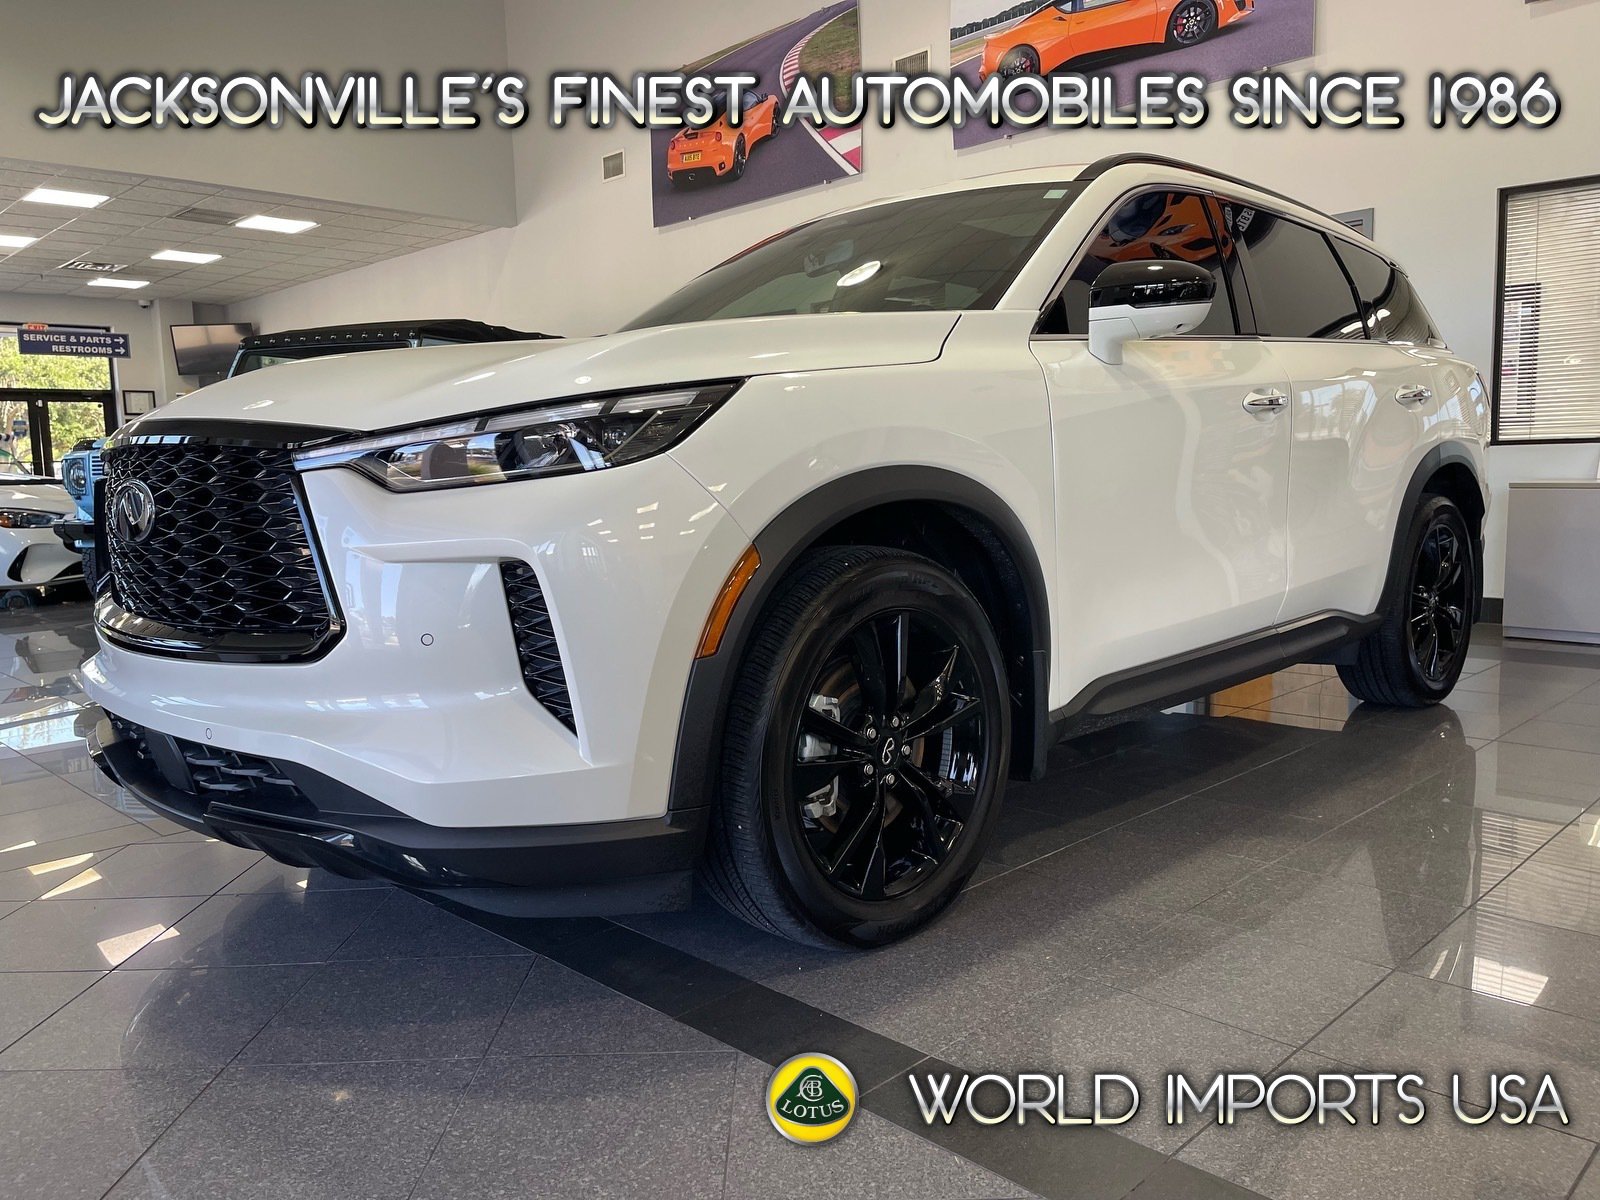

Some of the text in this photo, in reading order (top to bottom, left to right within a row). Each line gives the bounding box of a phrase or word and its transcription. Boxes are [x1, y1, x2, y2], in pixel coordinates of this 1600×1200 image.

[23, 334, 112, 344] SERVICE & PARTS
[52, 344, 113, 354] RESTROOMS
